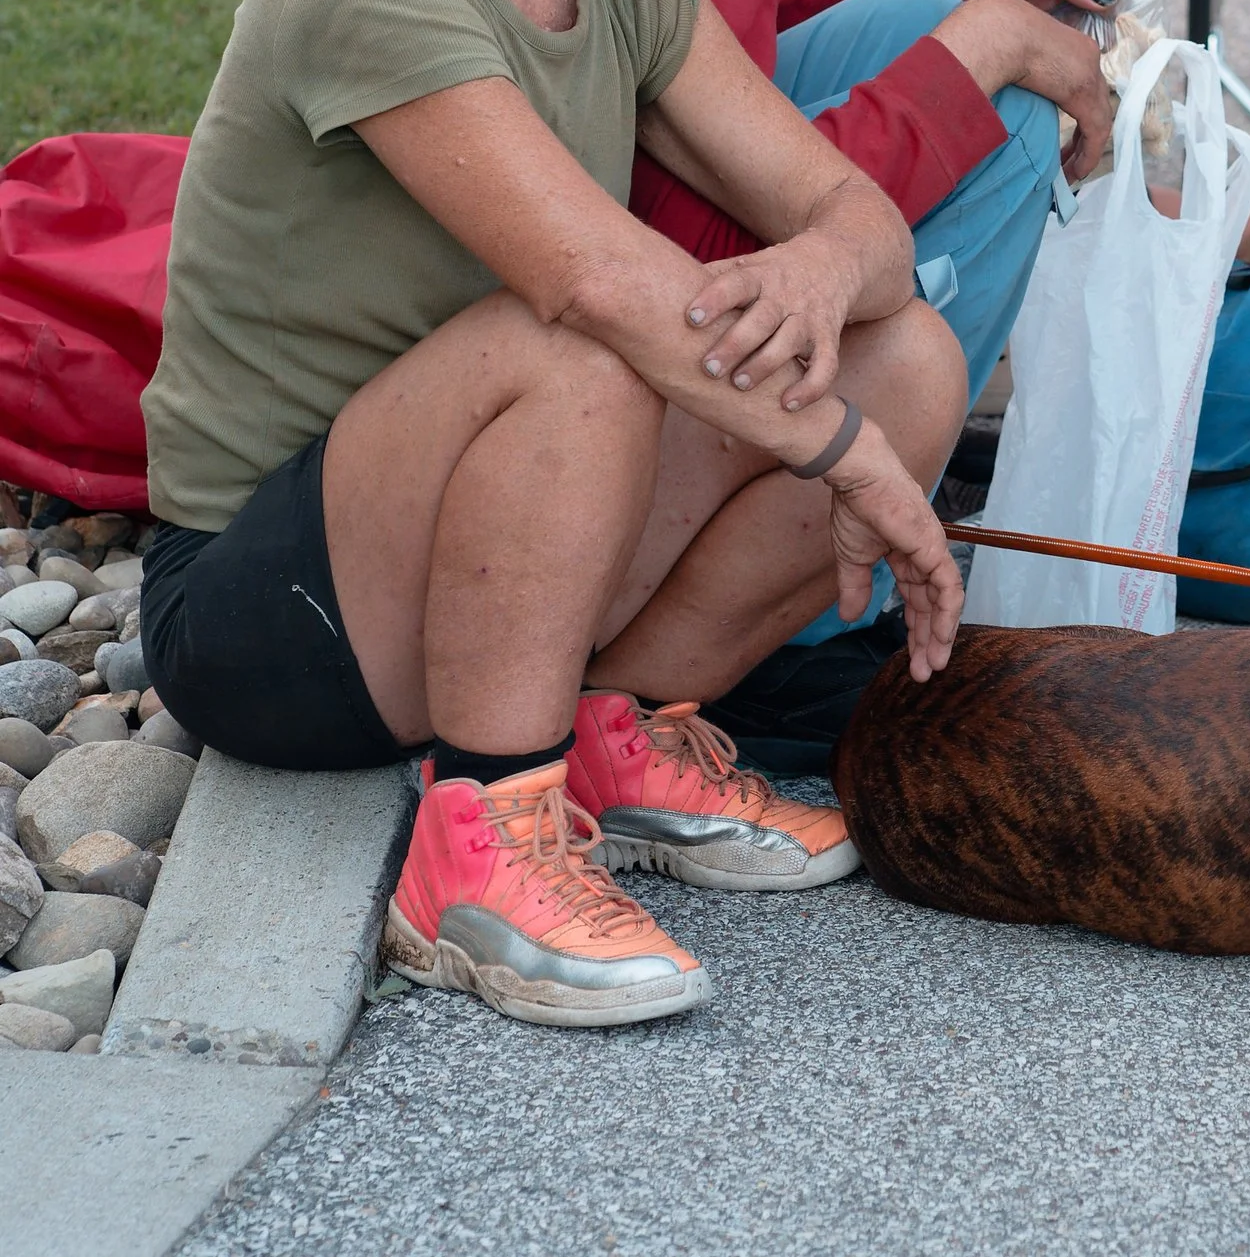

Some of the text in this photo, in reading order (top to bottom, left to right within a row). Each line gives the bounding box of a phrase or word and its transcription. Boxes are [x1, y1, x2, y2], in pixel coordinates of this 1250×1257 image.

[1133, 523, 1149, 549] EVITAR
[1142, 512, 1152, 523] EL
[1157, 467, 1167, 479] DE
